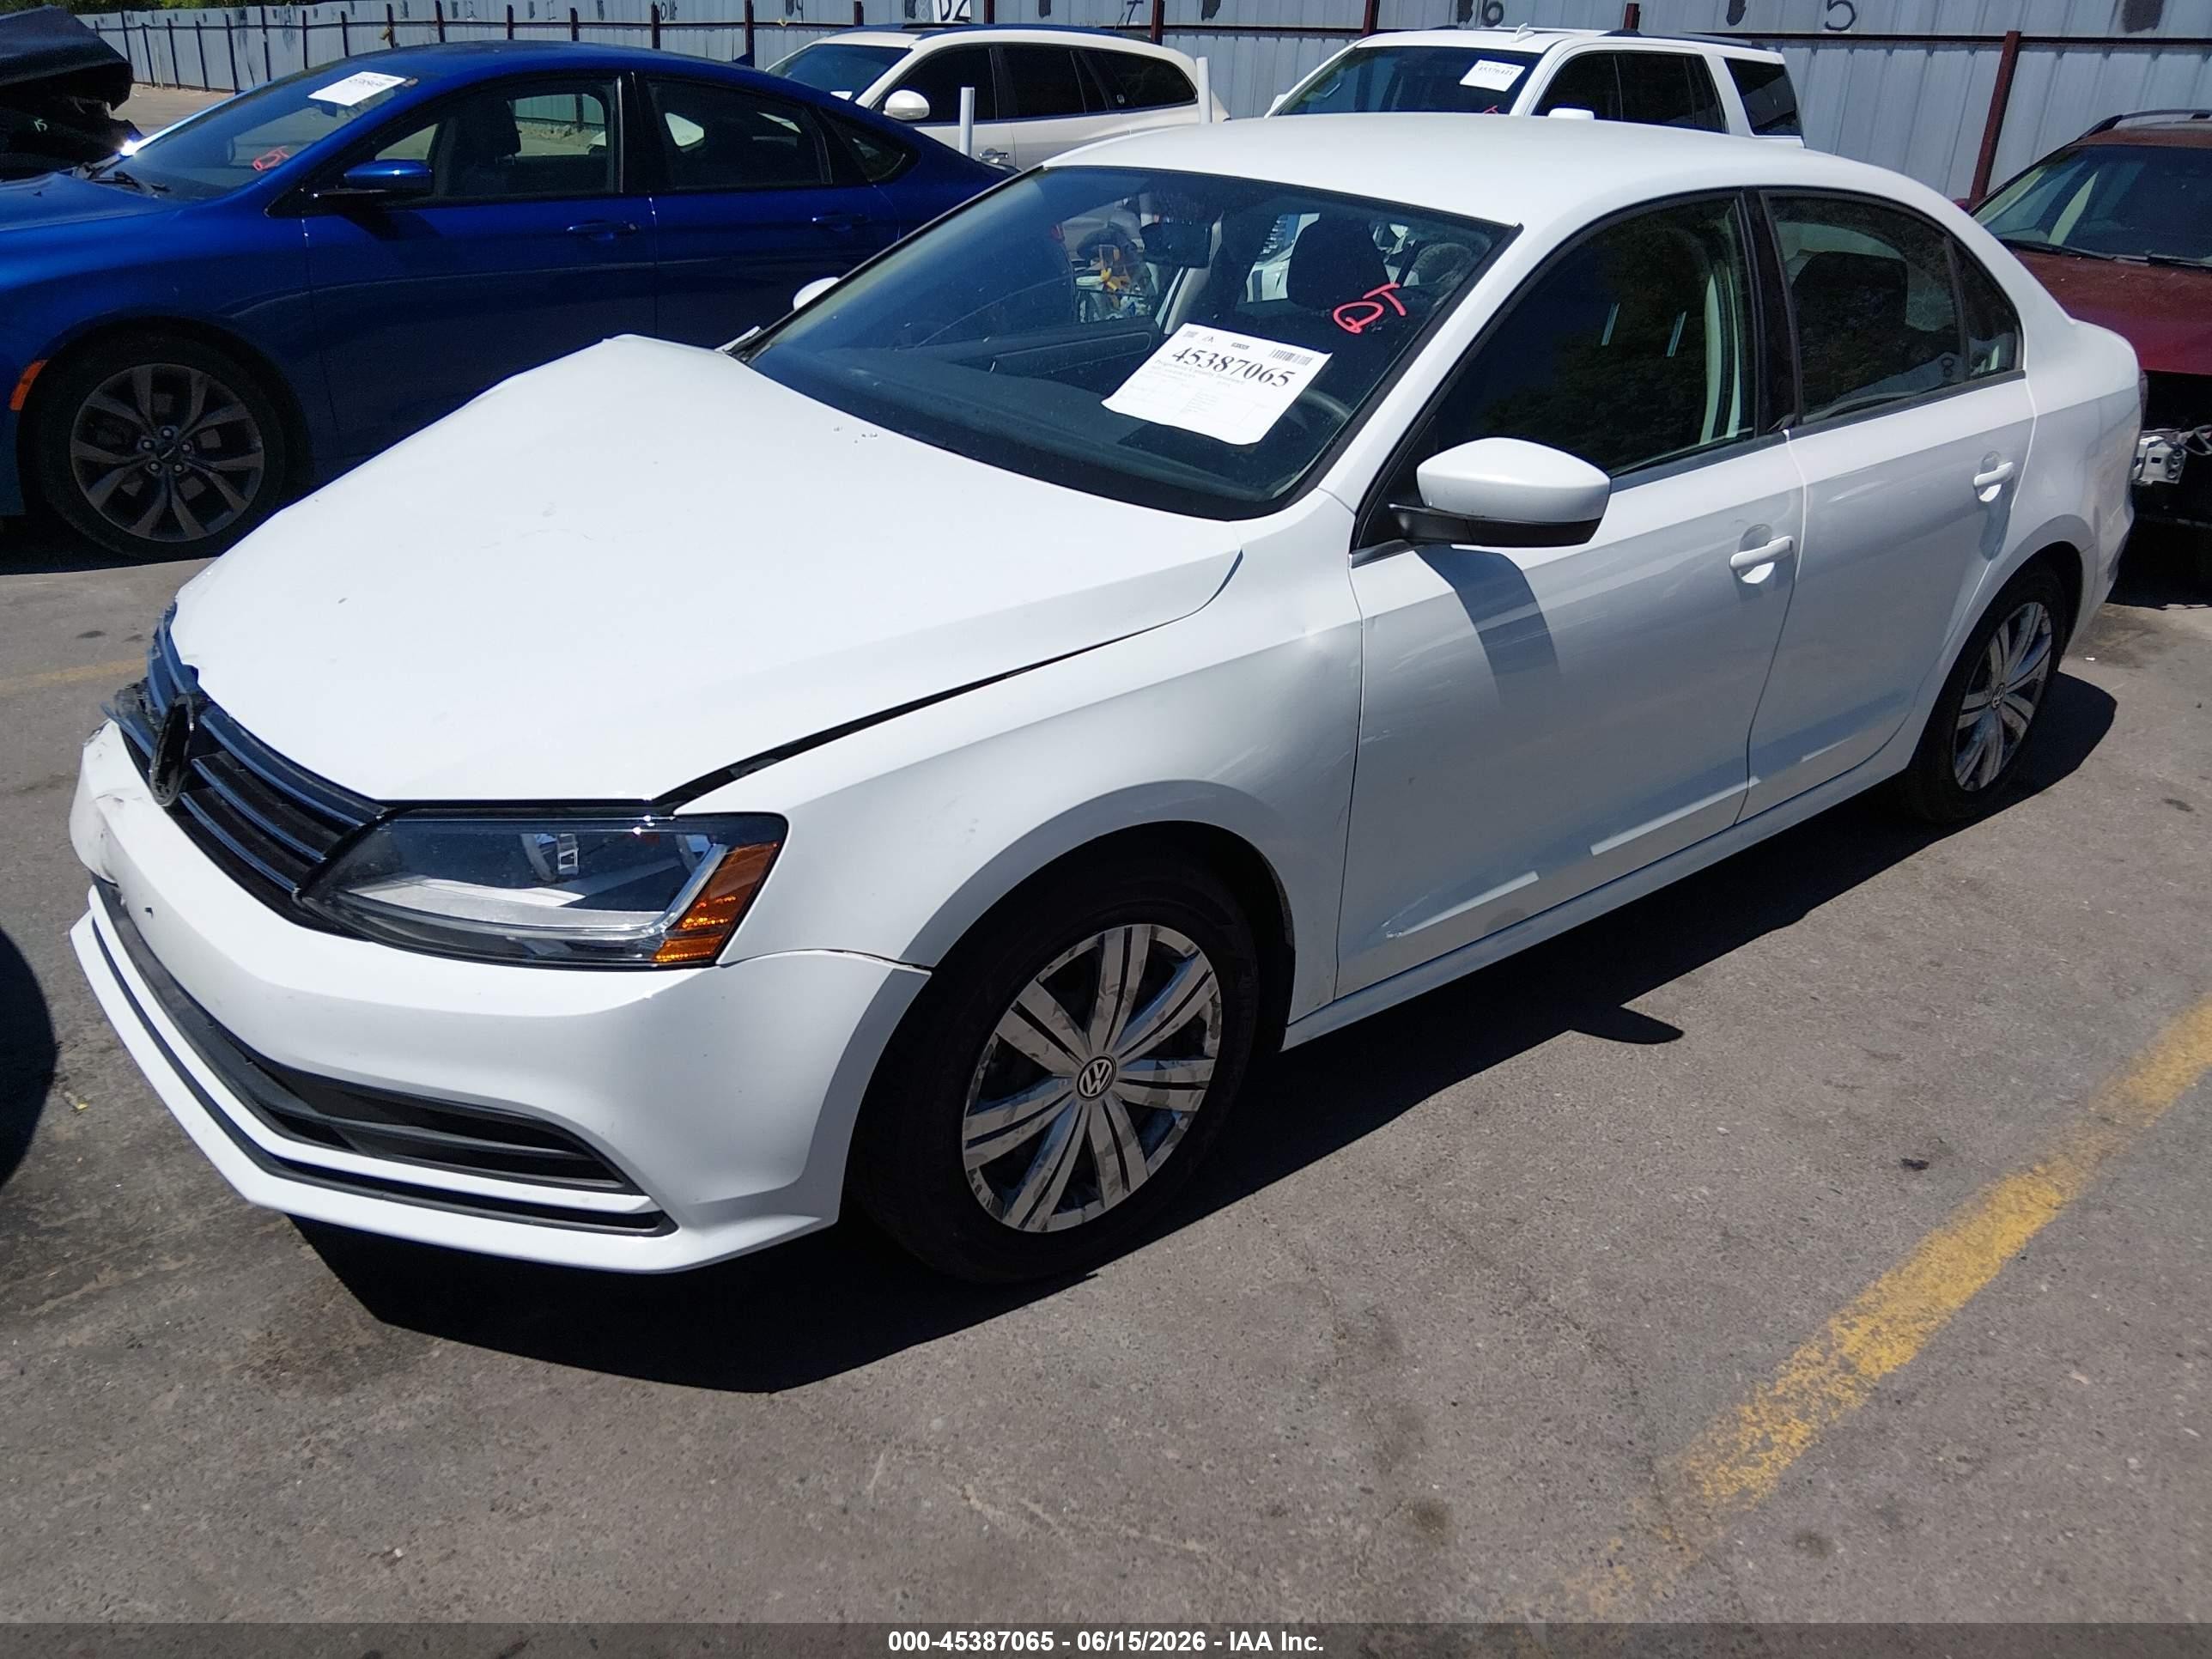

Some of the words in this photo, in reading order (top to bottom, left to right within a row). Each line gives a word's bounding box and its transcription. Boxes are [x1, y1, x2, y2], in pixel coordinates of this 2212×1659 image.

[1825, 0, 1857, 32] 5
[1334, 282, 1407, 334] QT
[1171, 346, 1296, 387] 45387065
